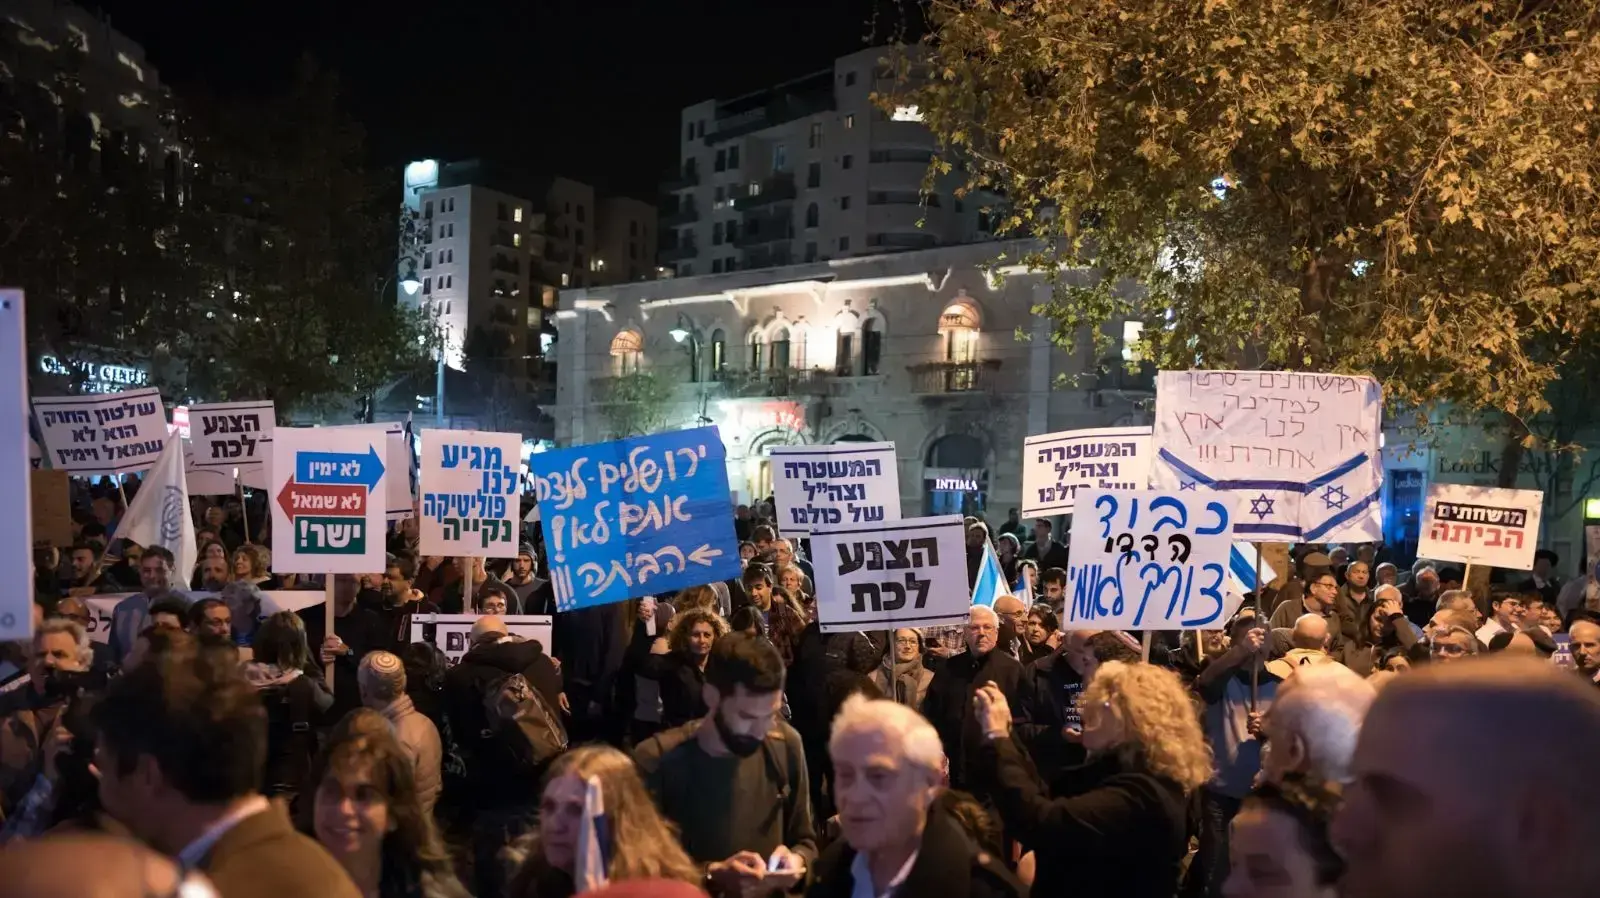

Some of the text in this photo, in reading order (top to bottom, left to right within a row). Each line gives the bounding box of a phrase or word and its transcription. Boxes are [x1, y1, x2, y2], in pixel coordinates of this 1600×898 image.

[42, 401, 156, 428] שלטון החוק
[1223, 393, 1320, 414] למדינה
[72, 424, 138, 442] הוא לא
[202, 414, 260, 436] הצנע
[1174, 411, 1369, 450] אין לנו ארץ
[57, 439, 164, 464] שמאל וימין
[211, 434, 256, 458] לכת
[441, 444, 502, 470] מגיע
[1038, 442, 1136, 463] המשטרה
[309, 460, 361, 480] לא ימין
[483, 465, 518, 495] לנו
[784, 459, 882, 479] המשטרה
[1054, 461, 1119, 480] וצה"ל
[802, 480, 866, 502] וצה"ל
[936, 479, 978, 490] INTIMA
[1038, 482, 1091, 502] ולנו
[291, 491, 362, 510] לא שמאל
[423, 489, 506, 523] פוליטיקה
[790, 502, 884, 524] של כולנו
[1095, 494, 1229, 538] כבוד
[1437, 504, 1524, 525] מושחתים
[300, 520, 361, 548] ישר!
[443, 518, 512, 548] נקייה
[1431, 522, 1524, 549] הביתה
[836, 537, 939, 576] הצנע
[1104, 532, 1192, 566] הדדי
[851, 572, 931, 612] לכת
[1132, 562, 1224, 626] צורך
